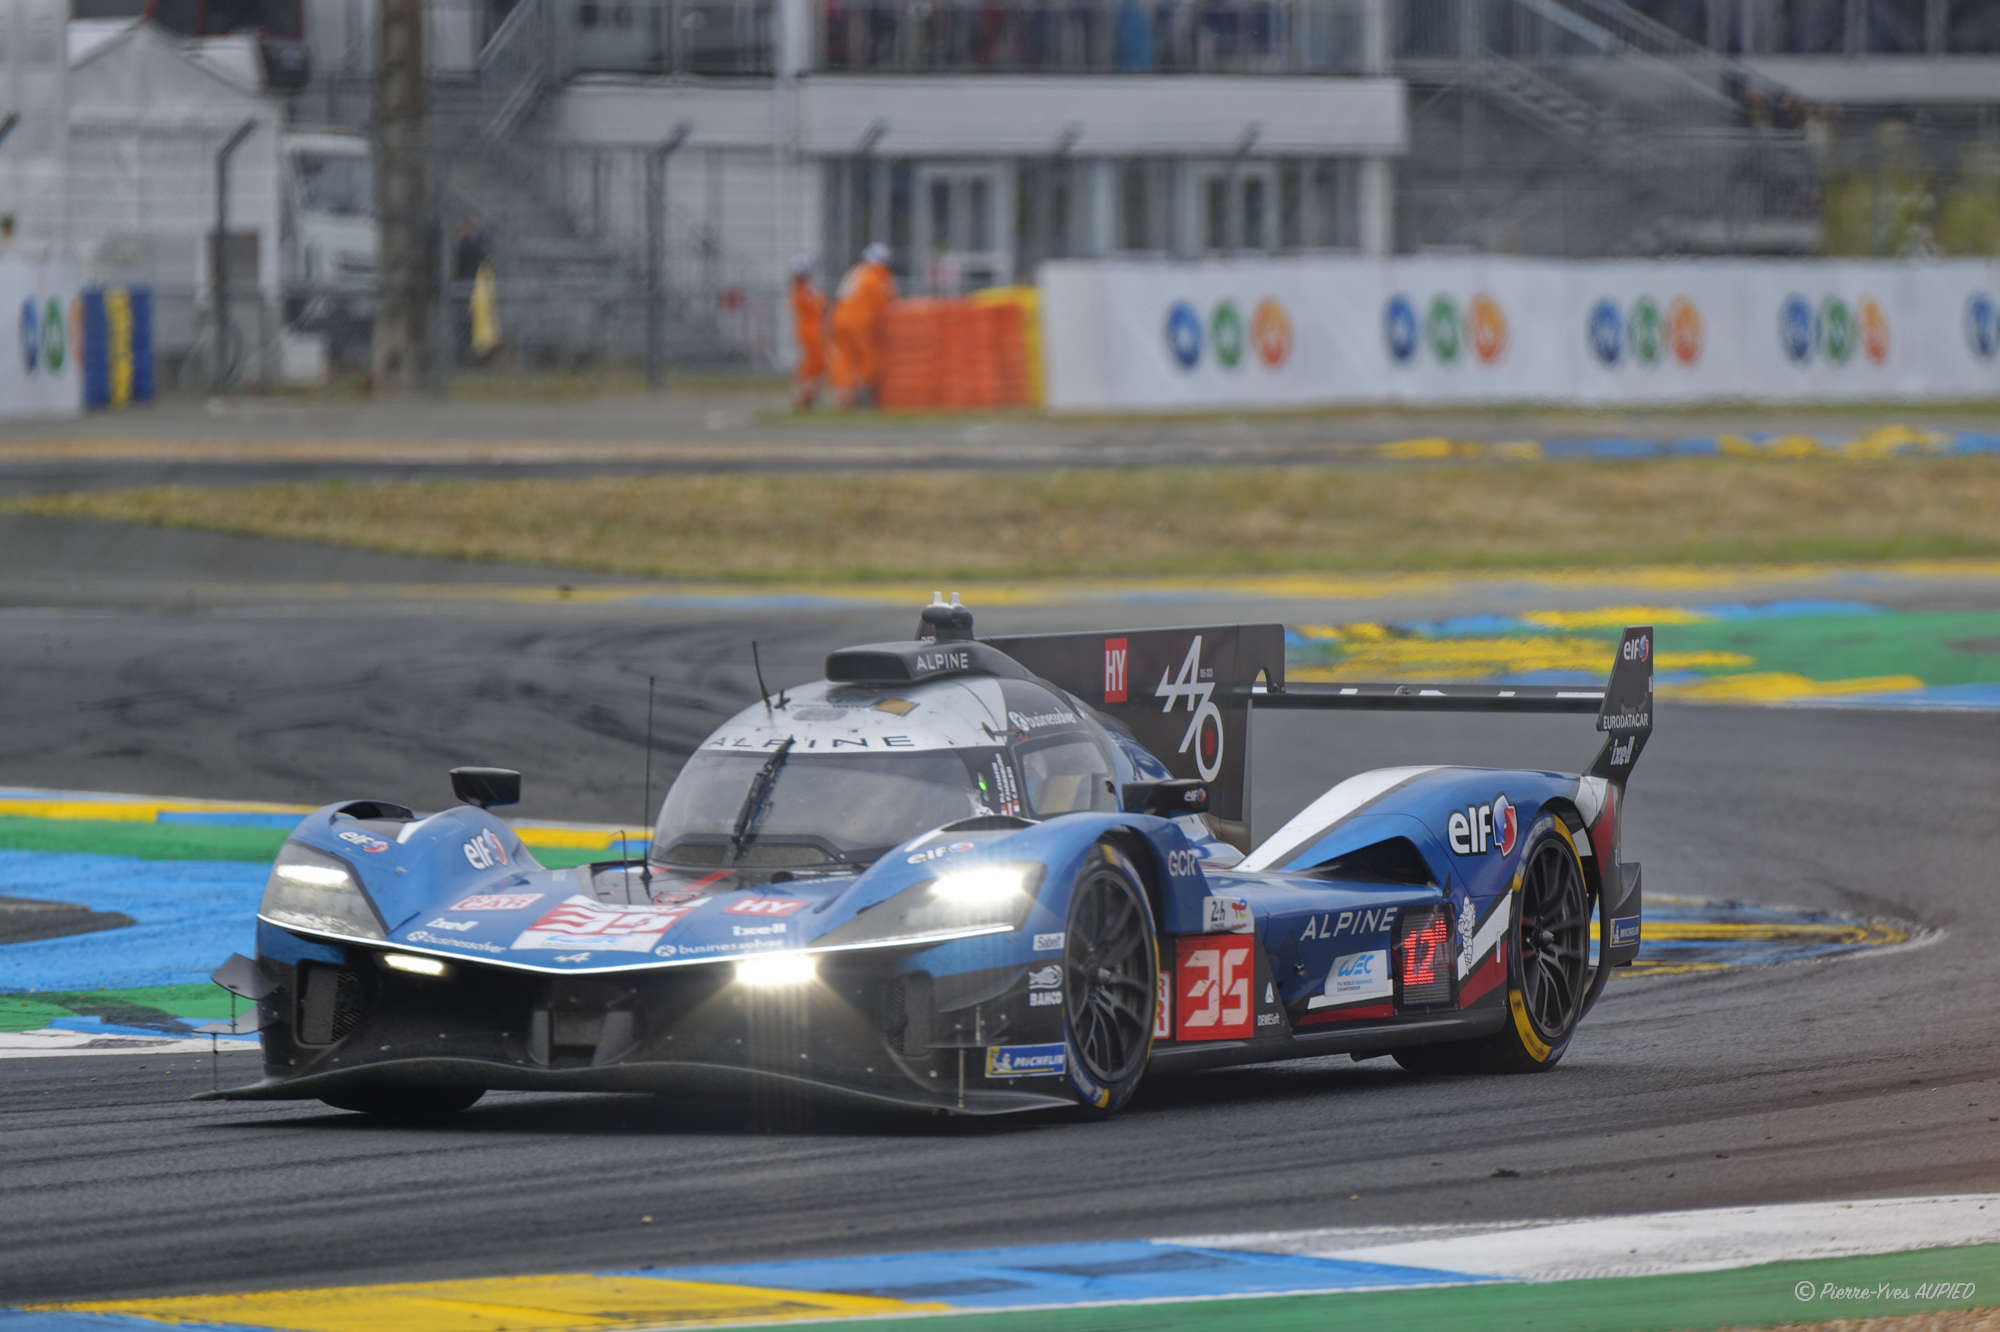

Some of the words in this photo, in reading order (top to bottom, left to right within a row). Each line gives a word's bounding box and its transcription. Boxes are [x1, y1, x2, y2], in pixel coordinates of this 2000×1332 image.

[1623, 638, 1640, 660] elf
[916, 652, 969, 670] ALPINE
[1105, 649, 1127, 692] HY
[1603, 713, 1649, 729] EURODATACAR
[338, 831, 375, 845] elf
[1449, 805, 1491, 854] elf
[464, 835, 494, 870] elf
[907, 846, 948, 864] elf
[732, 899, 797, 913] HY
[1300, 907, 1399, 942] ALPINE
[1184, 948, 1249, 1027] 35
